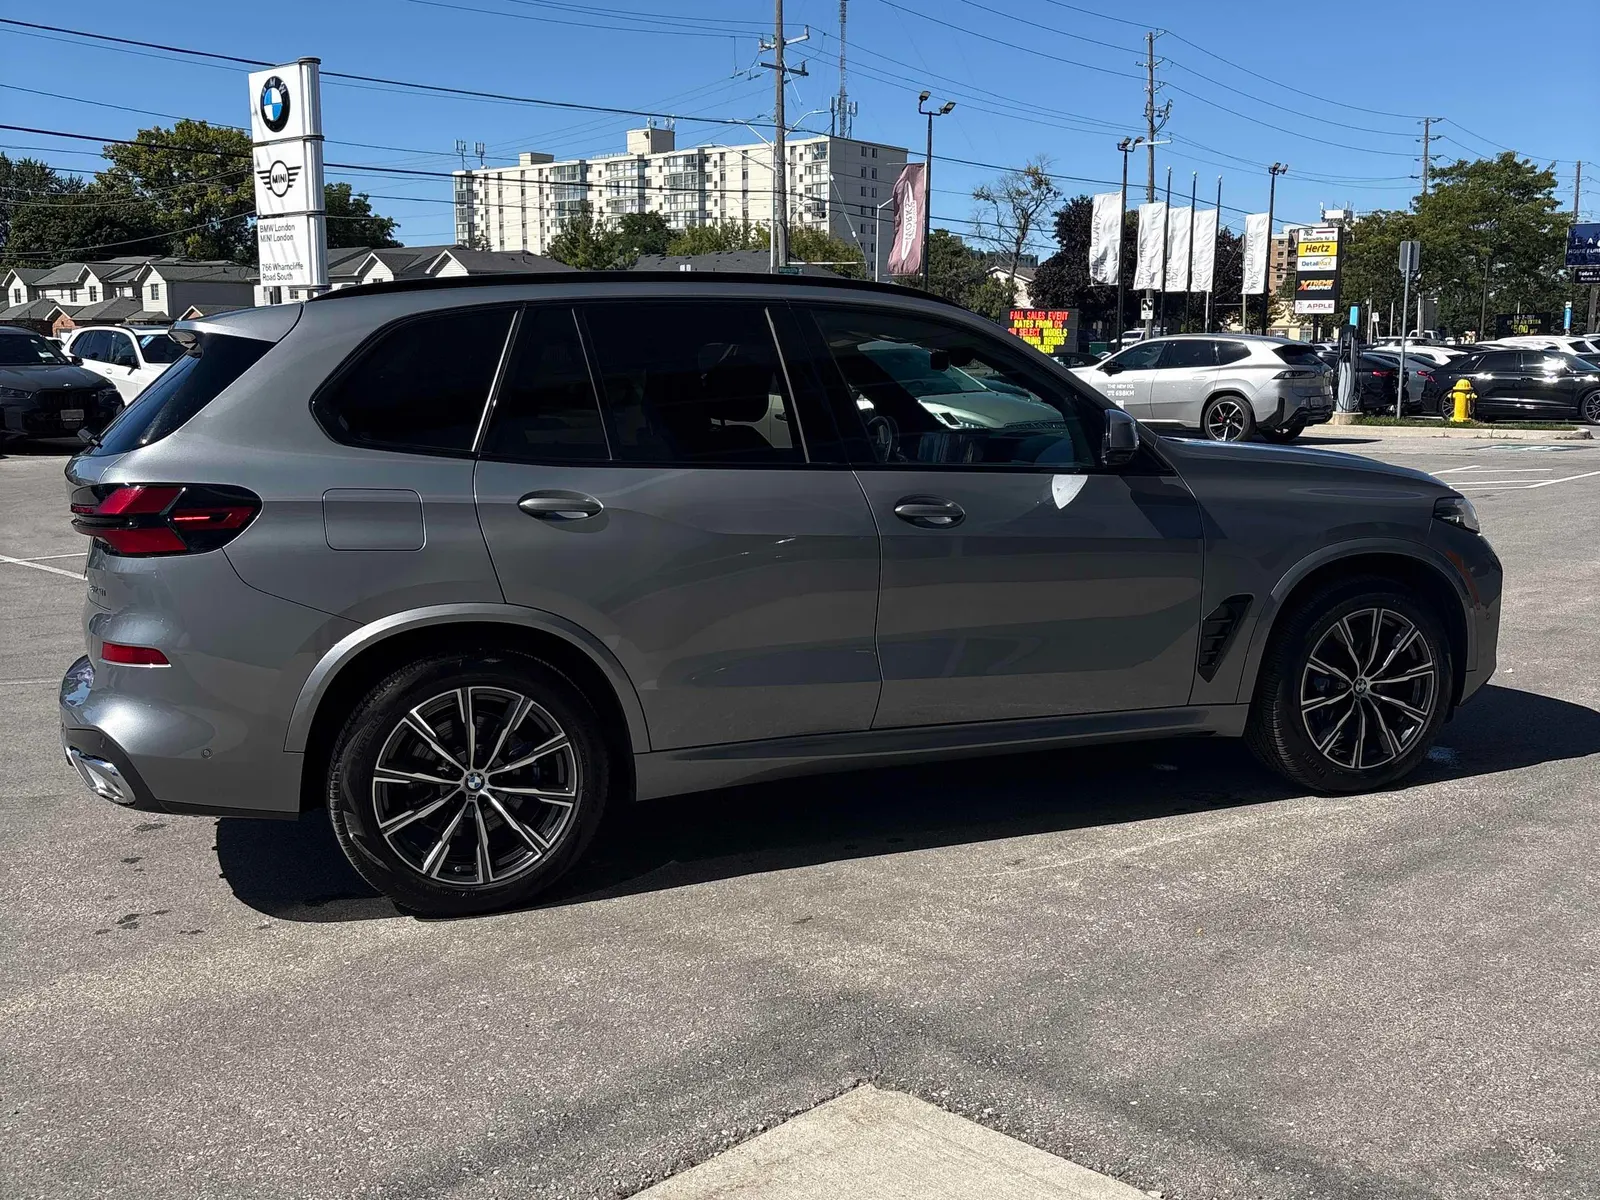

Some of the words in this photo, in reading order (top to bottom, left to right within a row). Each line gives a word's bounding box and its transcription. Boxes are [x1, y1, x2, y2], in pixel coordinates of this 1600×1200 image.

[272, 173, 287, 184] MINI
[260, 224, 274, 233] BMW
[275, 223, 295, 232] London
[260, 234, 272, 242] MINI
[274, 234, 294, 242] London
[1305, 244, 1330, 253] Hertz
[273, 261, 303, 271] Wharncliffe
[263, 273, 276, 281] Road
[277, 272, 293, 281] South
[1297, 280, 1334, 291] XTREME
[1010, 311, 1024, 320] FALL
[1027, 311, 1046, 320] SALES
[1048, 311, 1069, 320] EVENT
[1014, 320, 1034, 328] RATES
[1035, 320, 1053, 328] FROM
[1054, 320, 1063, 328] 0%
[1019, 328, 1040, 337] SELECT
[1043, 328, 1068, 337] MODELS
[1043, 336, 1065, 345] DEMOS
